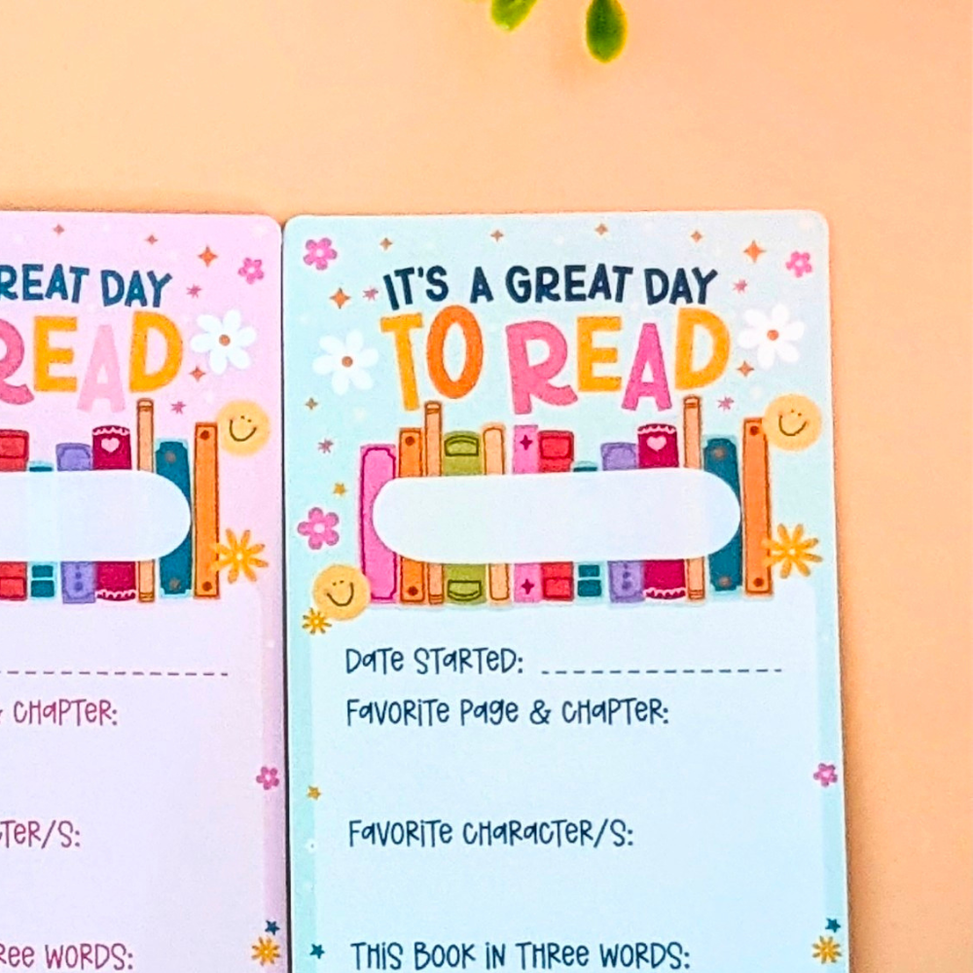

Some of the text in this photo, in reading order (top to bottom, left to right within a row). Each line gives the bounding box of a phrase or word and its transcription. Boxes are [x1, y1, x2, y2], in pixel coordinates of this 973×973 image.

[100, 269, 173, 308] DAY
[382, 263, 719, 311] IT'S A GREAT DAY
[379, 304, 732, 415] TO READ
[345, 646, 524, 676] DaTe STaRTeD:
[12, 698, 118, 728] CHaPTeR:
[346, 696, 670, 728] FaVORiTe Page & CHaPTeR:
[348, 817, 634, 849] FaVORiTe CHaRaCTeR/S:
[44, 942, 134, 972] WORDS:
[349, 940, 691, 972] THiS BOOK iN THRee WORDS:
